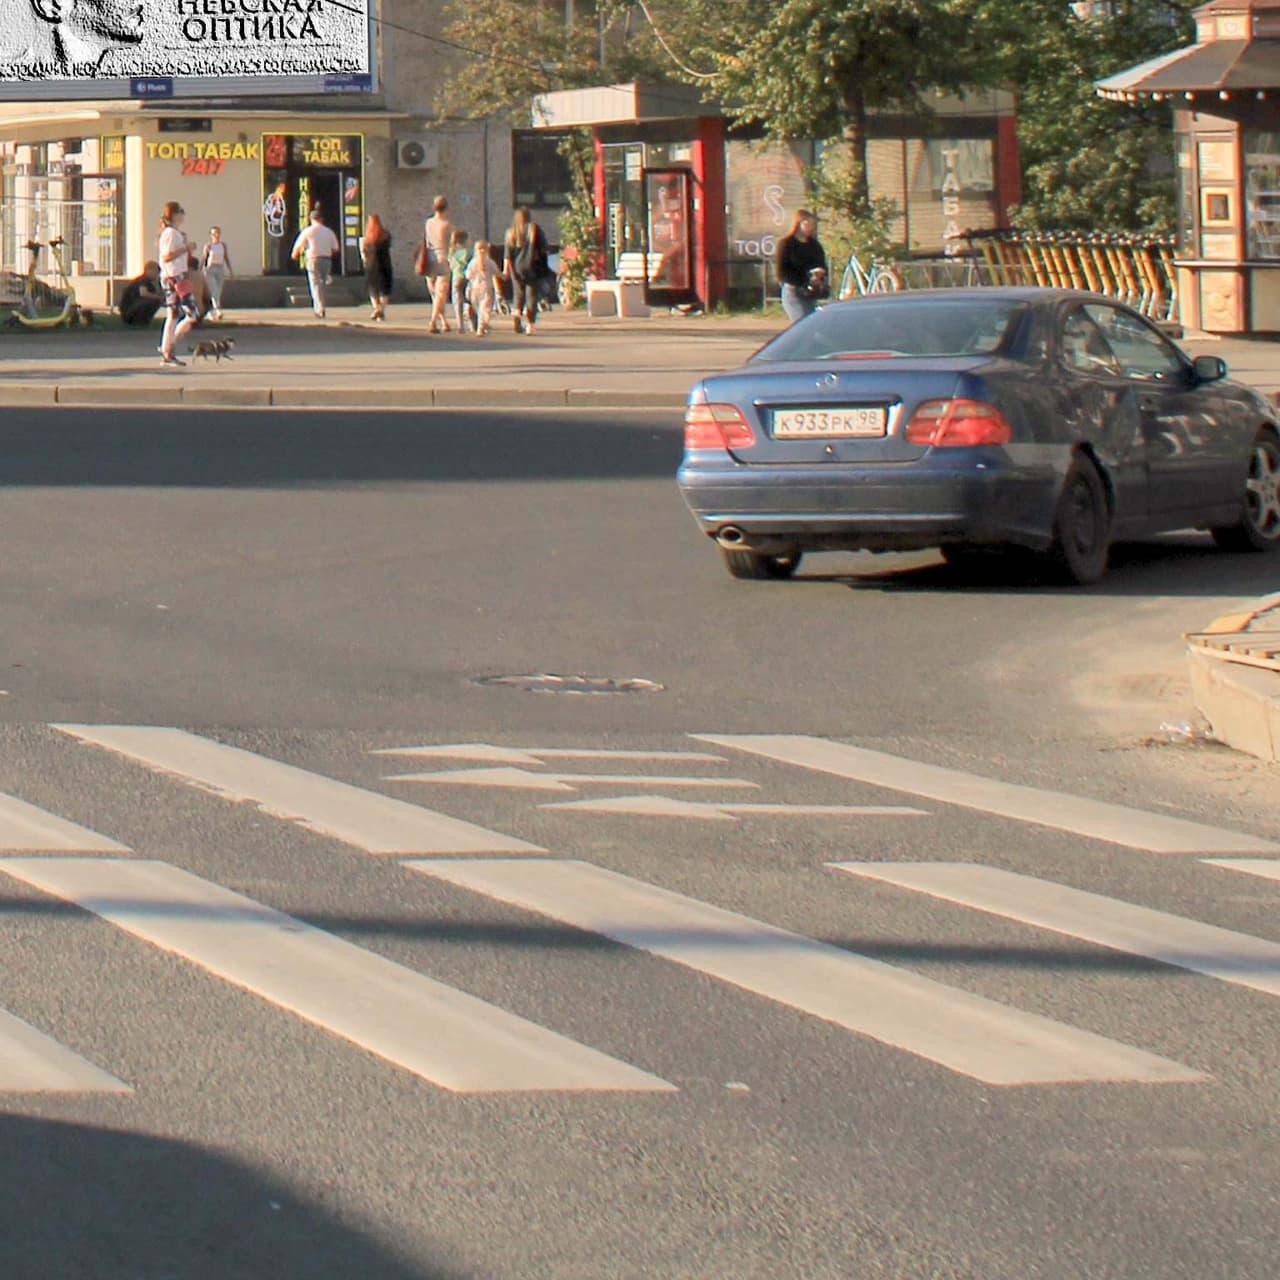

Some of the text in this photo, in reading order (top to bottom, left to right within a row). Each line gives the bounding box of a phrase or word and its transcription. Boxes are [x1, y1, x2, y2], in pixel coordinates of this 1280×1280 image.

[182, 13, 322, 42] ОПТИКА
[146, 143, 188, 159] ТОП
[194, 143, 259, 160] ТАБАК
[311, 139, 342, 151] ТОП
[303, 151, 350, 163] ТАБАК
[858, 411, 878, 425] 98
